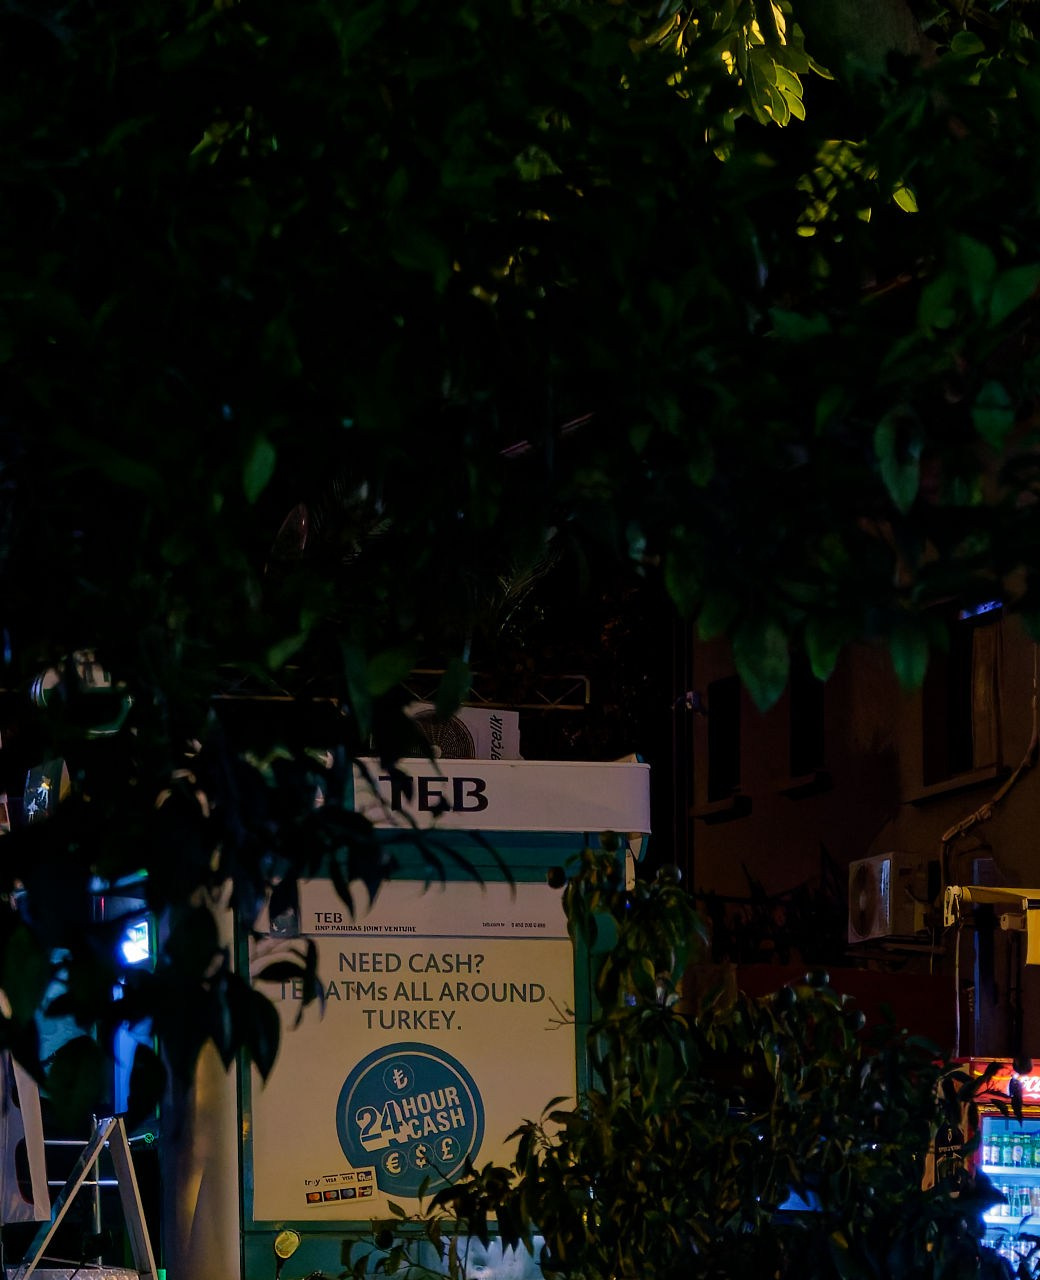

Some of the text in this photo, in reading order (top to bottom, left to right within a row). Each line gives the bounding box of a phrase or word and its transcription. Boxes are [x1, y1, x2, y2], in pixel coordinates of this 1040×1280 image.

[378, 775, 489, 812] TEB
[314, 912, 343, 923] TEB
[339, 952, 485, 974] NEED CASH?
[280, 980, 546, 1003] TE ATMs ALL AROUND
[363, 1009, 462, 1030] TURKEY.
[356, 1086, 461, 1149] 24 HOUR
[407, 1107, 466, 1140] CASH
